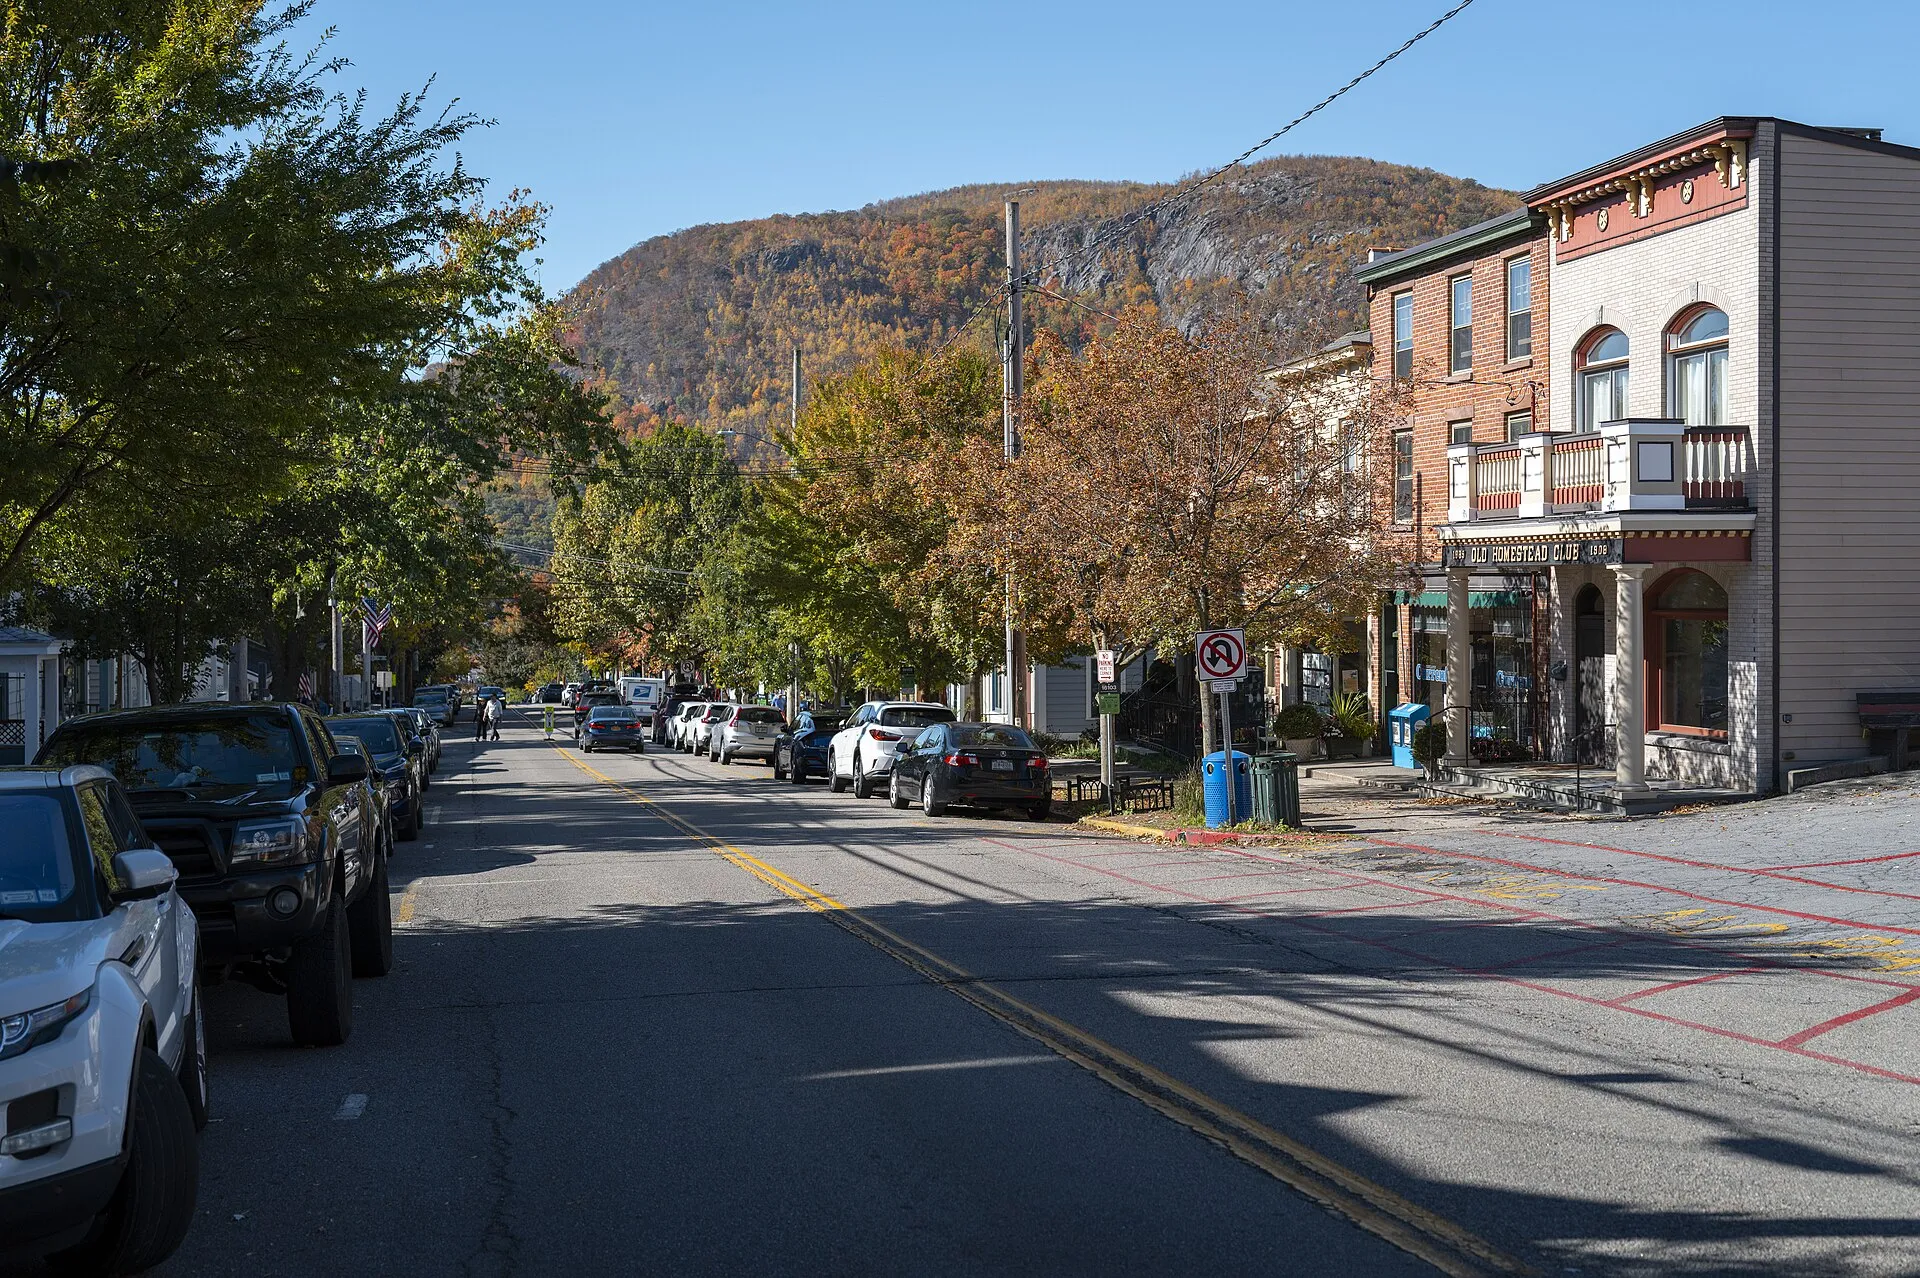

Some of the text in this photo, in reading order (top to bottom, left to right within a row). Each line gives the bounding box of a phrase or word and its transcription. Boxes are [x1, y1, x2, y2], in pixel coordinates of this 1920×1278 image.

[1471, 547, 1487, 563] OLD
[1492, 545, 1548, 562] HOMESTEAD
[1553, 543, 1579, 561] CLUB
[1590, 544, 1607, 556] 1908
